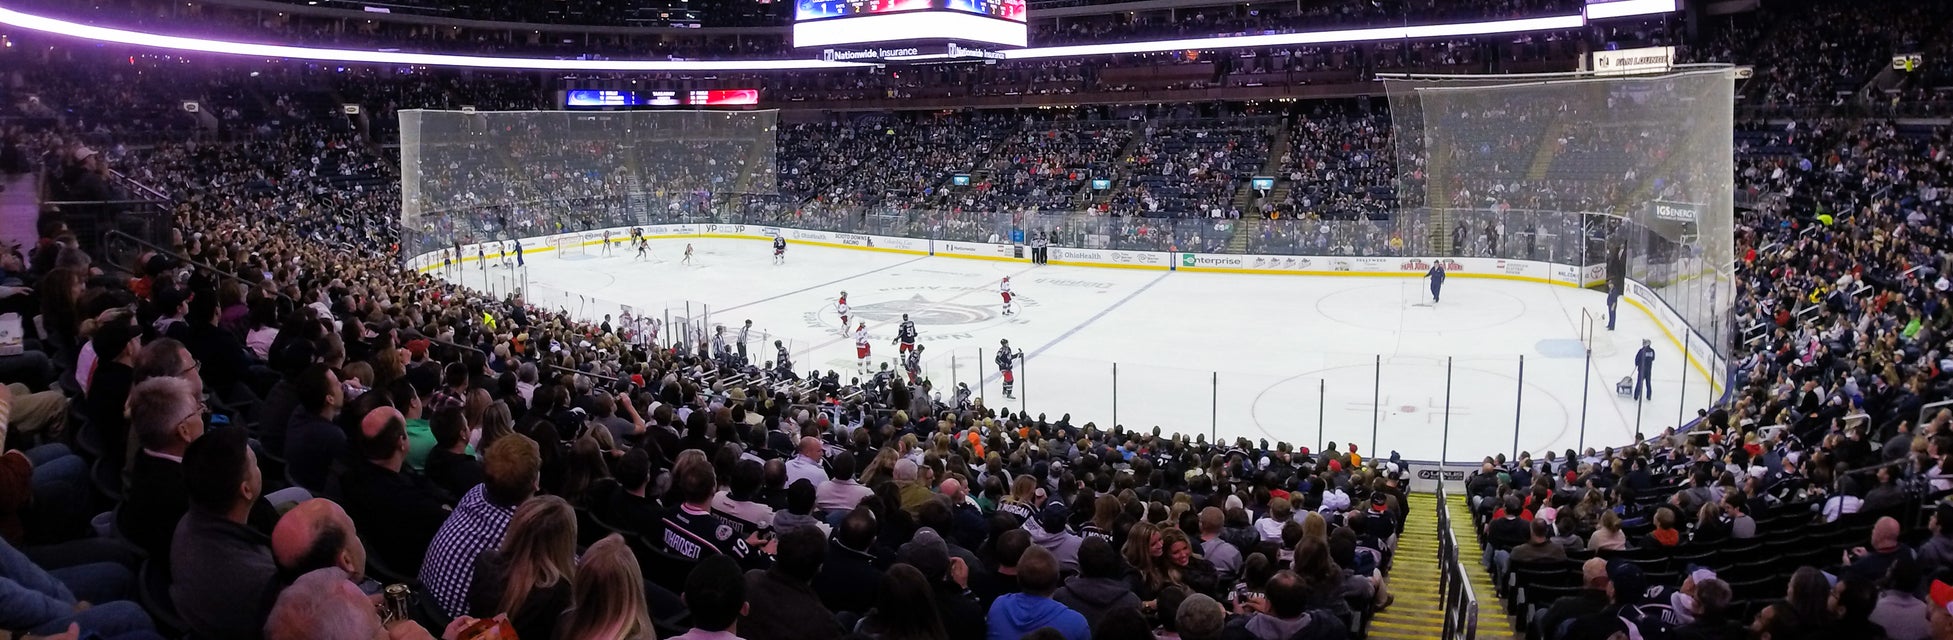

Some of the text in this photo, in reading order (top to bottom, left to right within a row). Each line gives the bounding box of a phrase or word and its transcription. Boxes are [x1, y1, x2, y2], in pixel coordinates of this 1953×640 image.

[834, 47, 918, 60] Nationwide Insurance
[956, 46, 1005, 60] Nationwide Insurance
[1656, 206, 1670, 216] IGS
[1670, 208, 1696, 218] ENERGY
[1064, 252, 1101, 260] OhioHealth
[732, 538, 750, 558] 19
